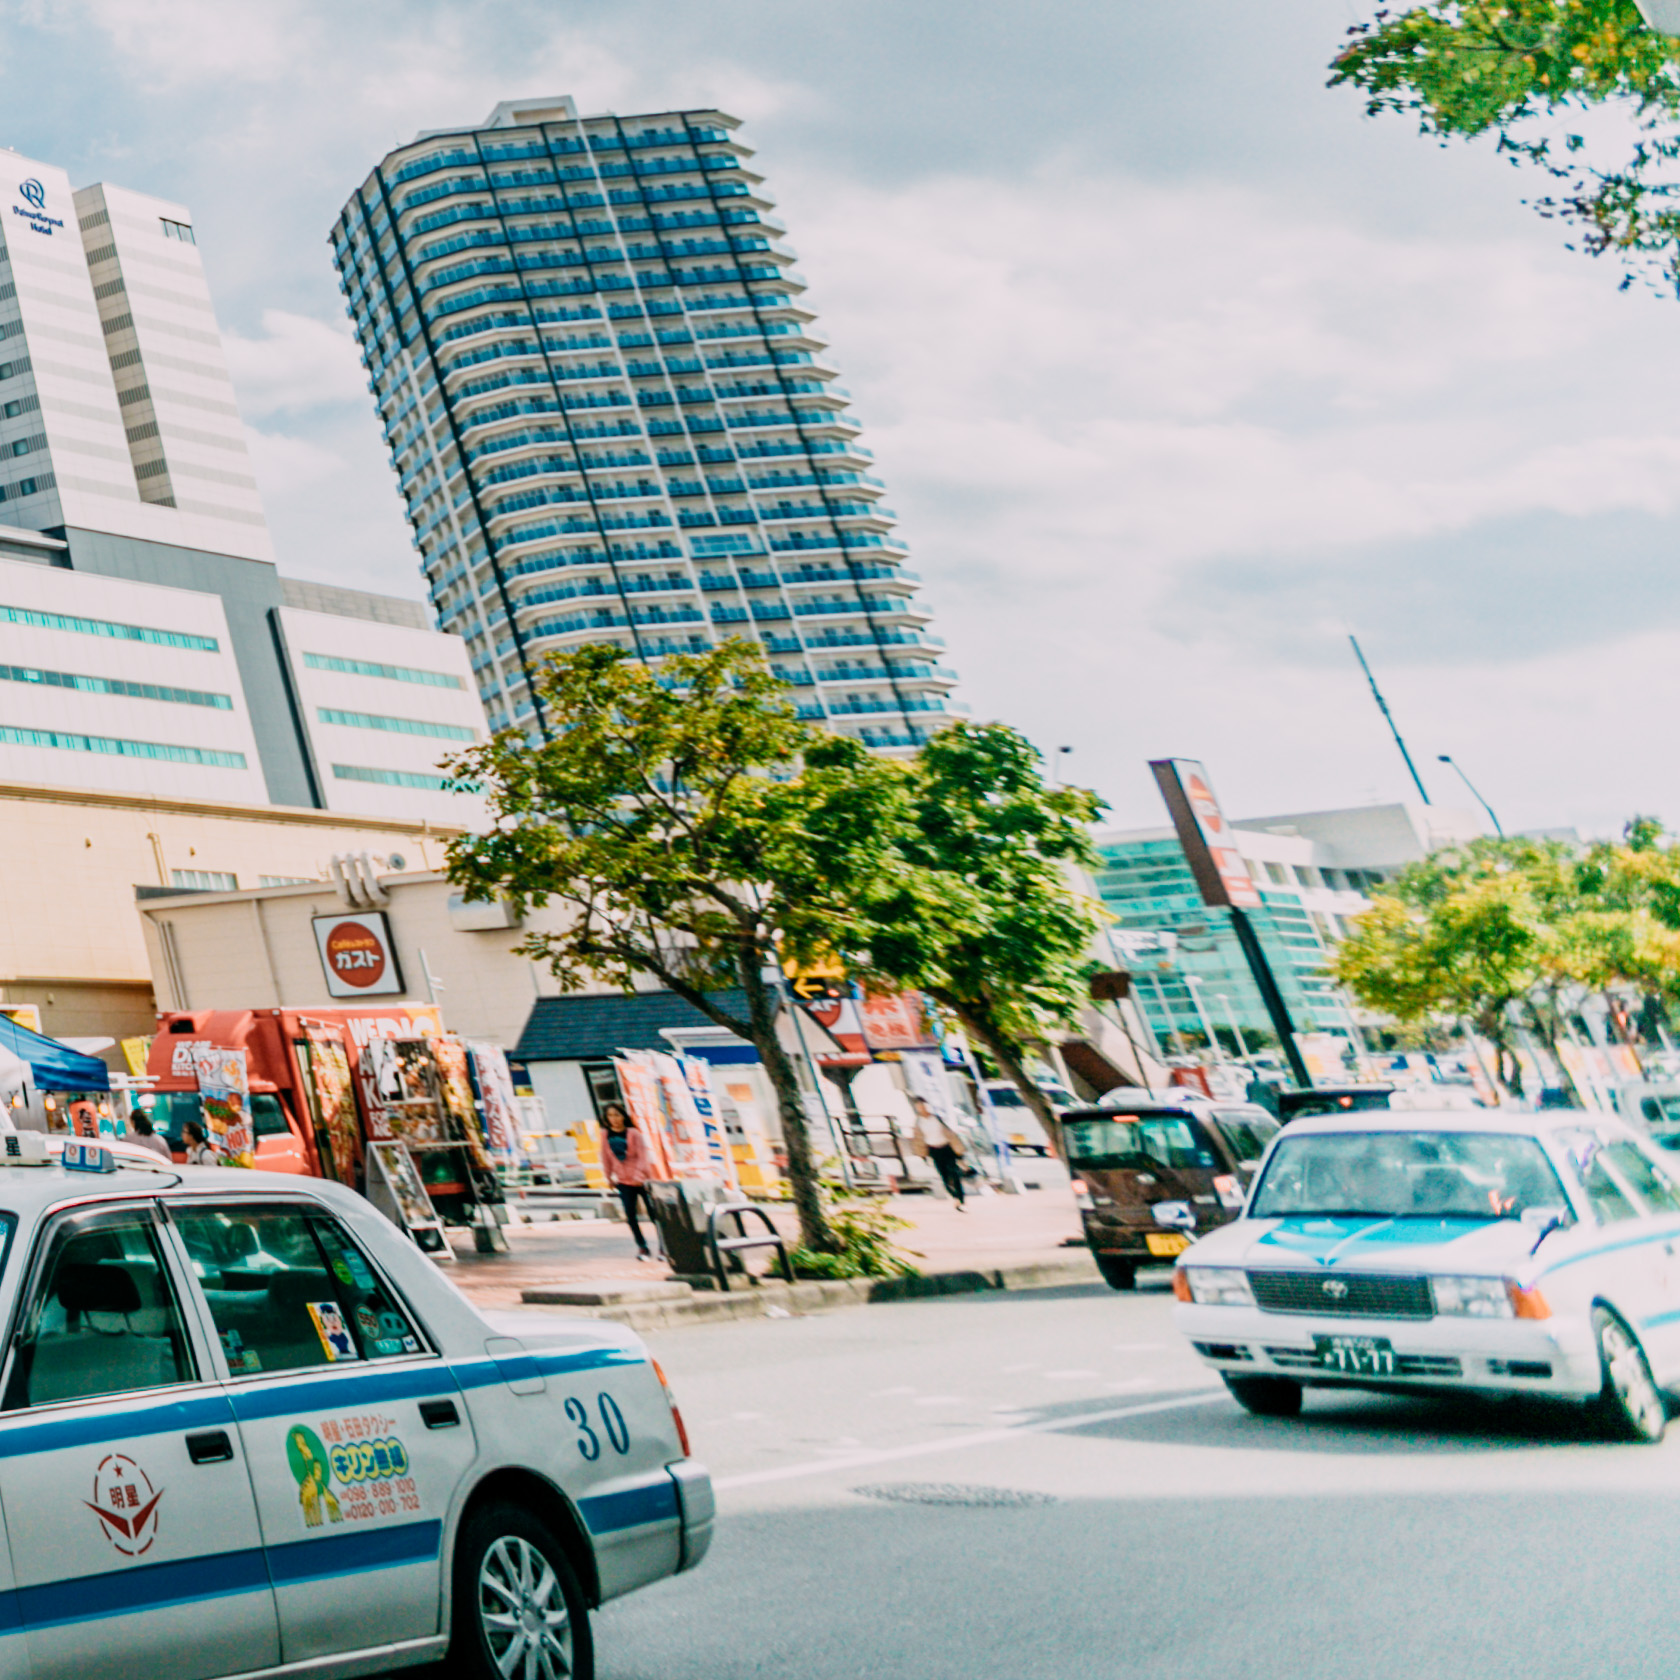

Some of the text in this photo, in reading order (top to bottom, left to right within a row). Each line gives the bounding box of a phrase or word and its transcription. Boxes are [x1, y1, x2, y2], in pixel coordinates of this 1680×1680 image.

[335, 950, 381, 970] ガスト
[226, 1127, 251, 1150] HOT
[563, 1391, 630, 1461] 30
[109, 1483, 141, 1509] 明星
